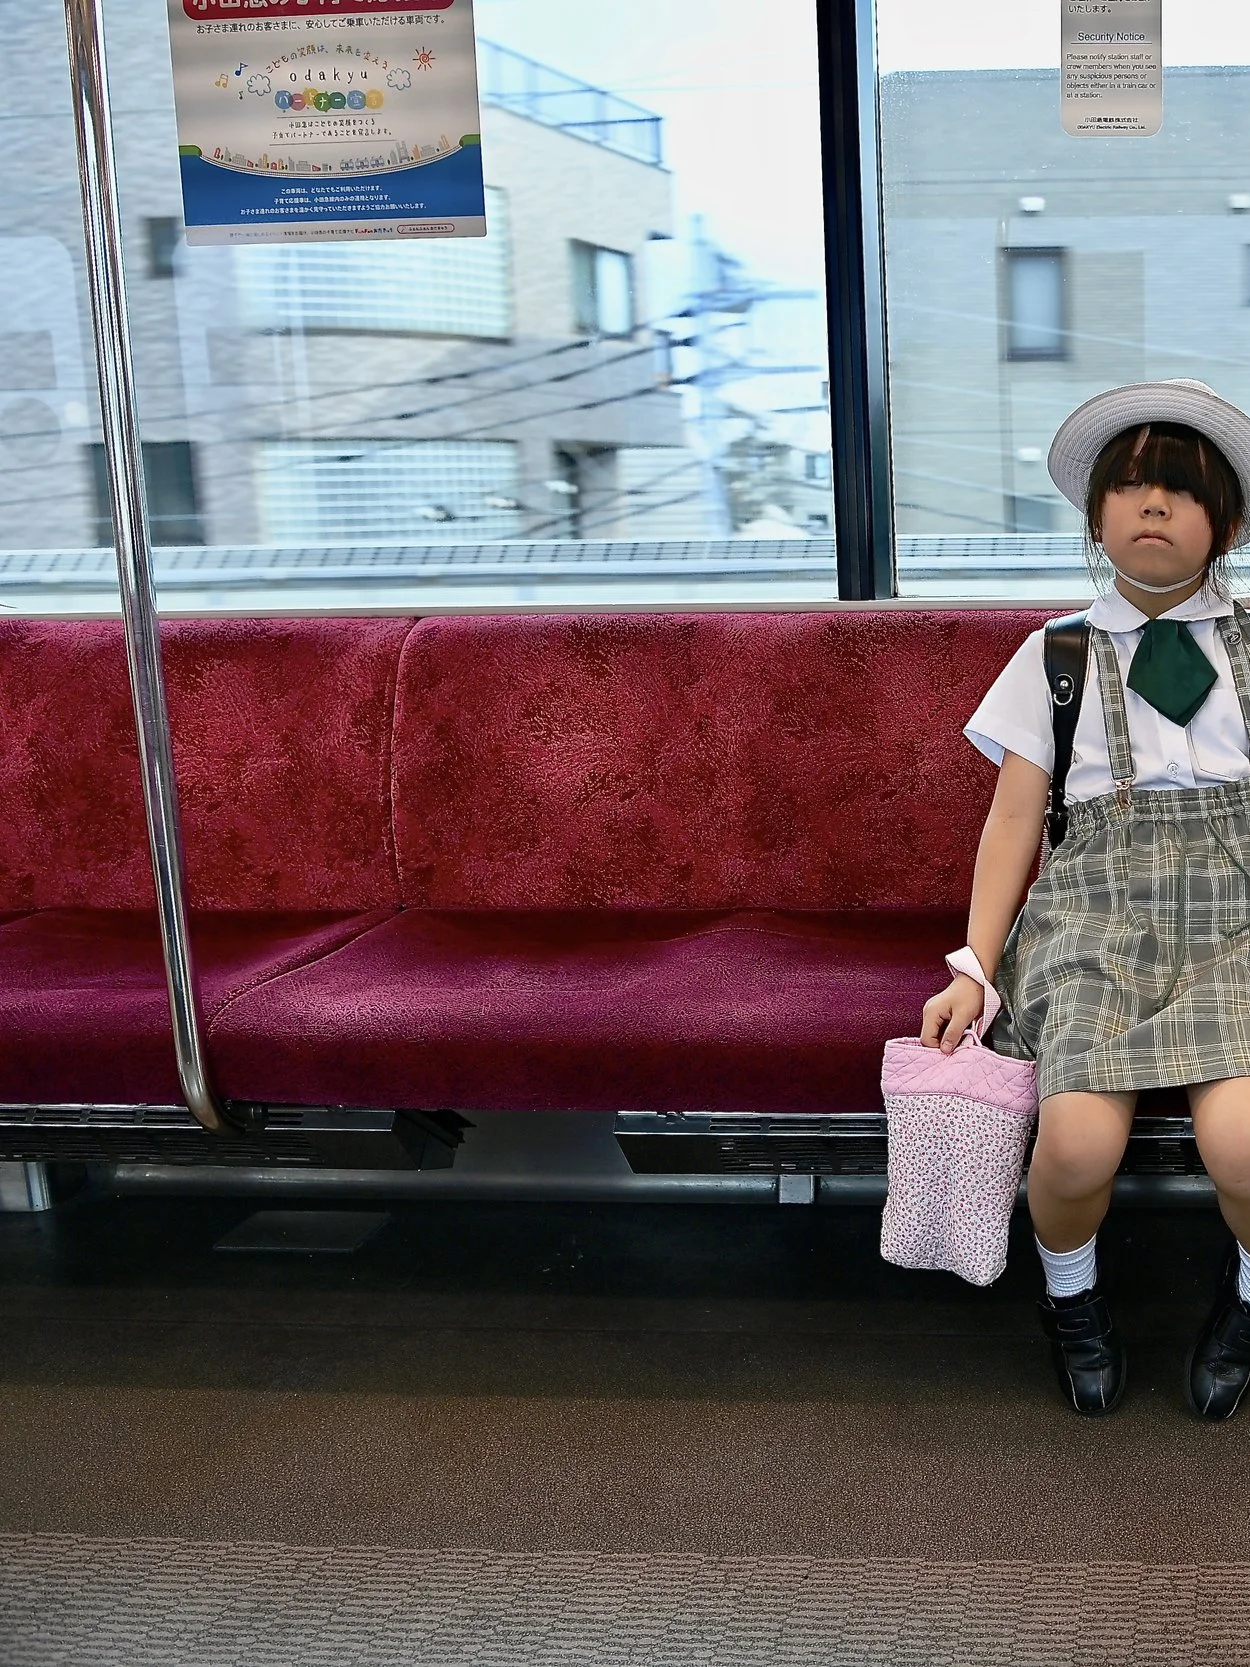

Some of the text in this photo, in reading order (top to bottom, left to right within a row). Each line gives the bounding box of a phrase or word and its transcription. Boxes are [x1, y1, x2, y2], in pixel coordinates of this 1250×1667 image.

[1068, 5, 1111, 13] いたします。
[1077, 32, 1145, 42] Security Notice
[1089, 53, 1106, 61] notify
[289, 68, 368, 84] odakyu
[1079, 72, 1112, 80] suspicious
[1066, 82, 1089, 90] objects
